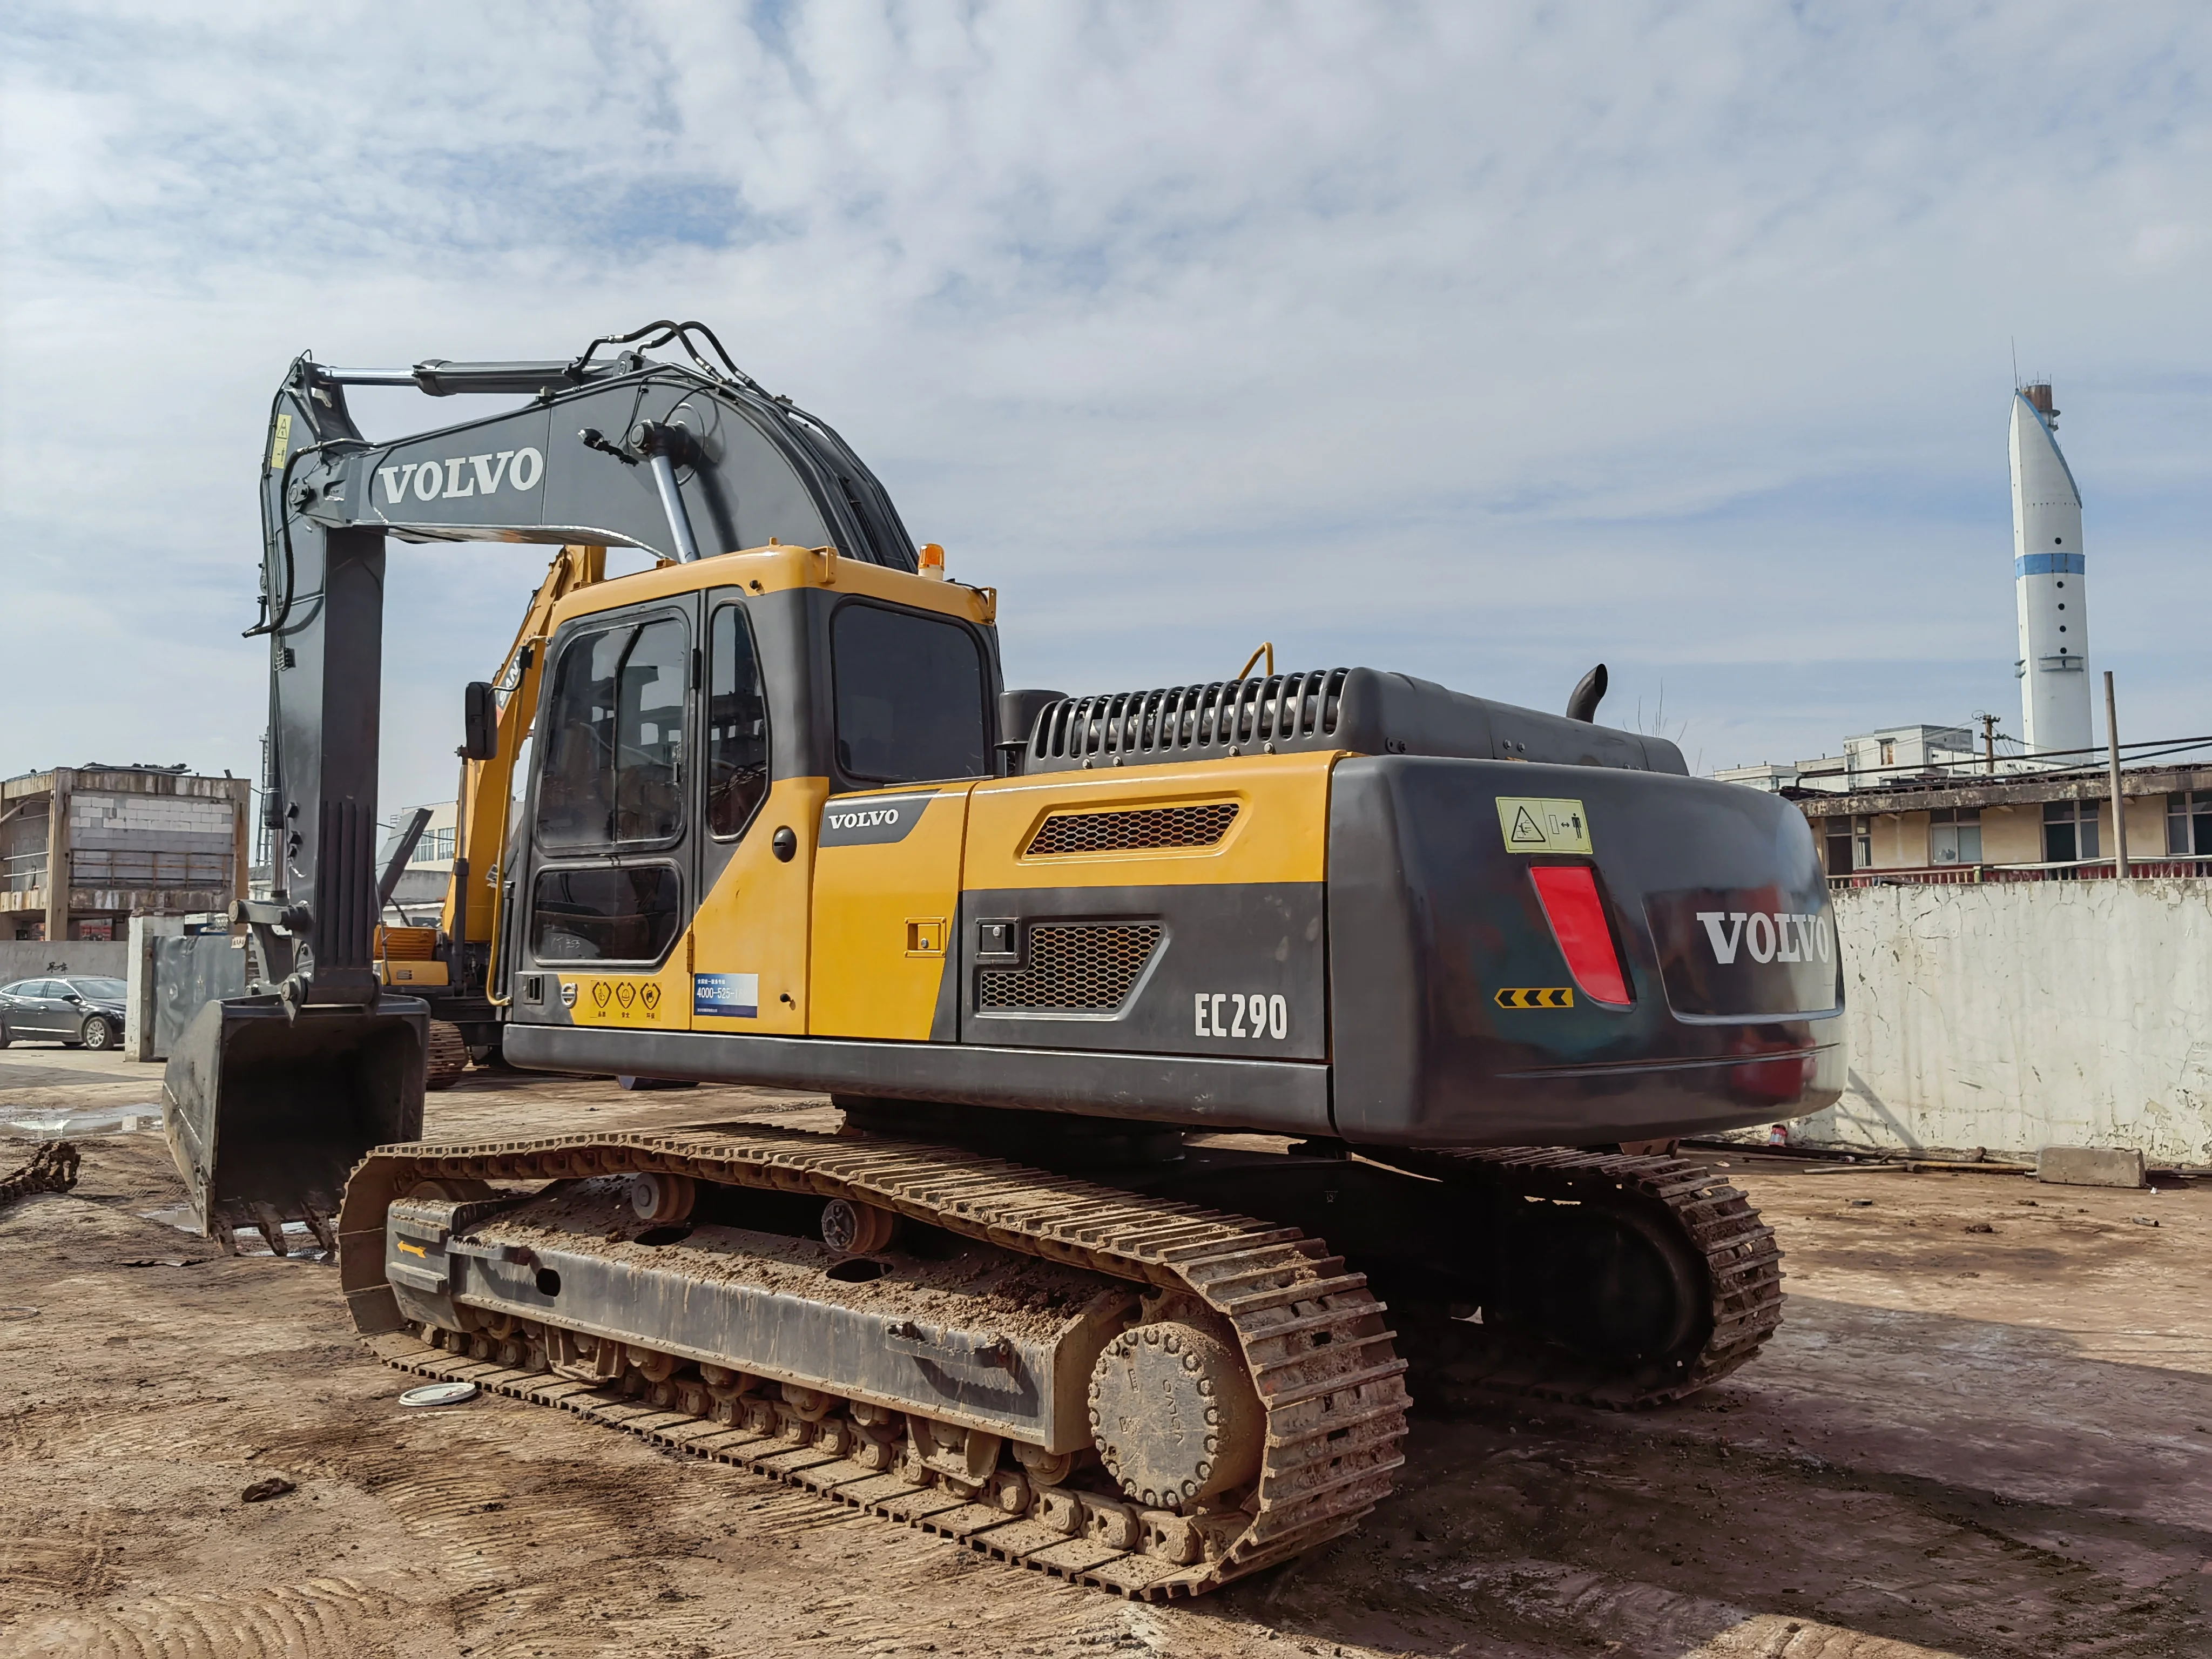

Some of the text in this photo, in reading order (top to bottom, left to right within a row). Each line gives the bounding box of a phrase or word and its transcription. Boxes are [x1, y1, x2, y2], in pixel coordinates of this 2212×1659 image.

[379, 447, 544, 504] VOLVO
[828, 809, 899, 830] VOLVO
[1696, 911, 1829, 964] VOLVO
[1195, 993, 1287, 1040] EC290
